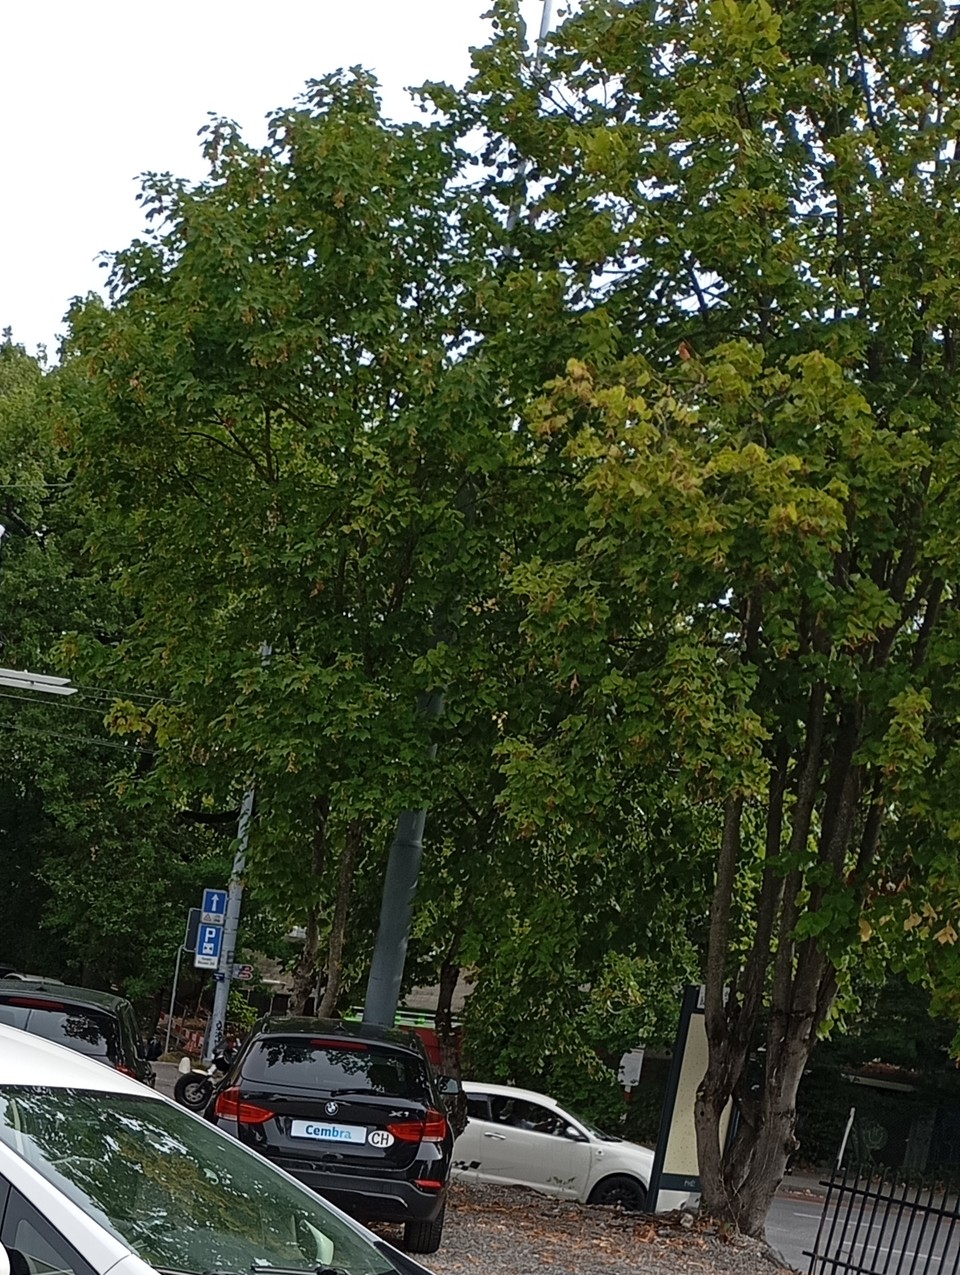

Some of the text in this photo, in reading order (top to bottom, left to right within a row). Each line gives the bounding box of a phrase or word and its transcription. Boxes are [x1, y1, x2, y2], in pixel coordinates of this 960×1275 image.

[204, 927, 216, 942] P
[388, 1110, 409, 1118] X1
[305, 1124, 352, 1140] Cembra
[371, 1132, 390, 1146] CH
